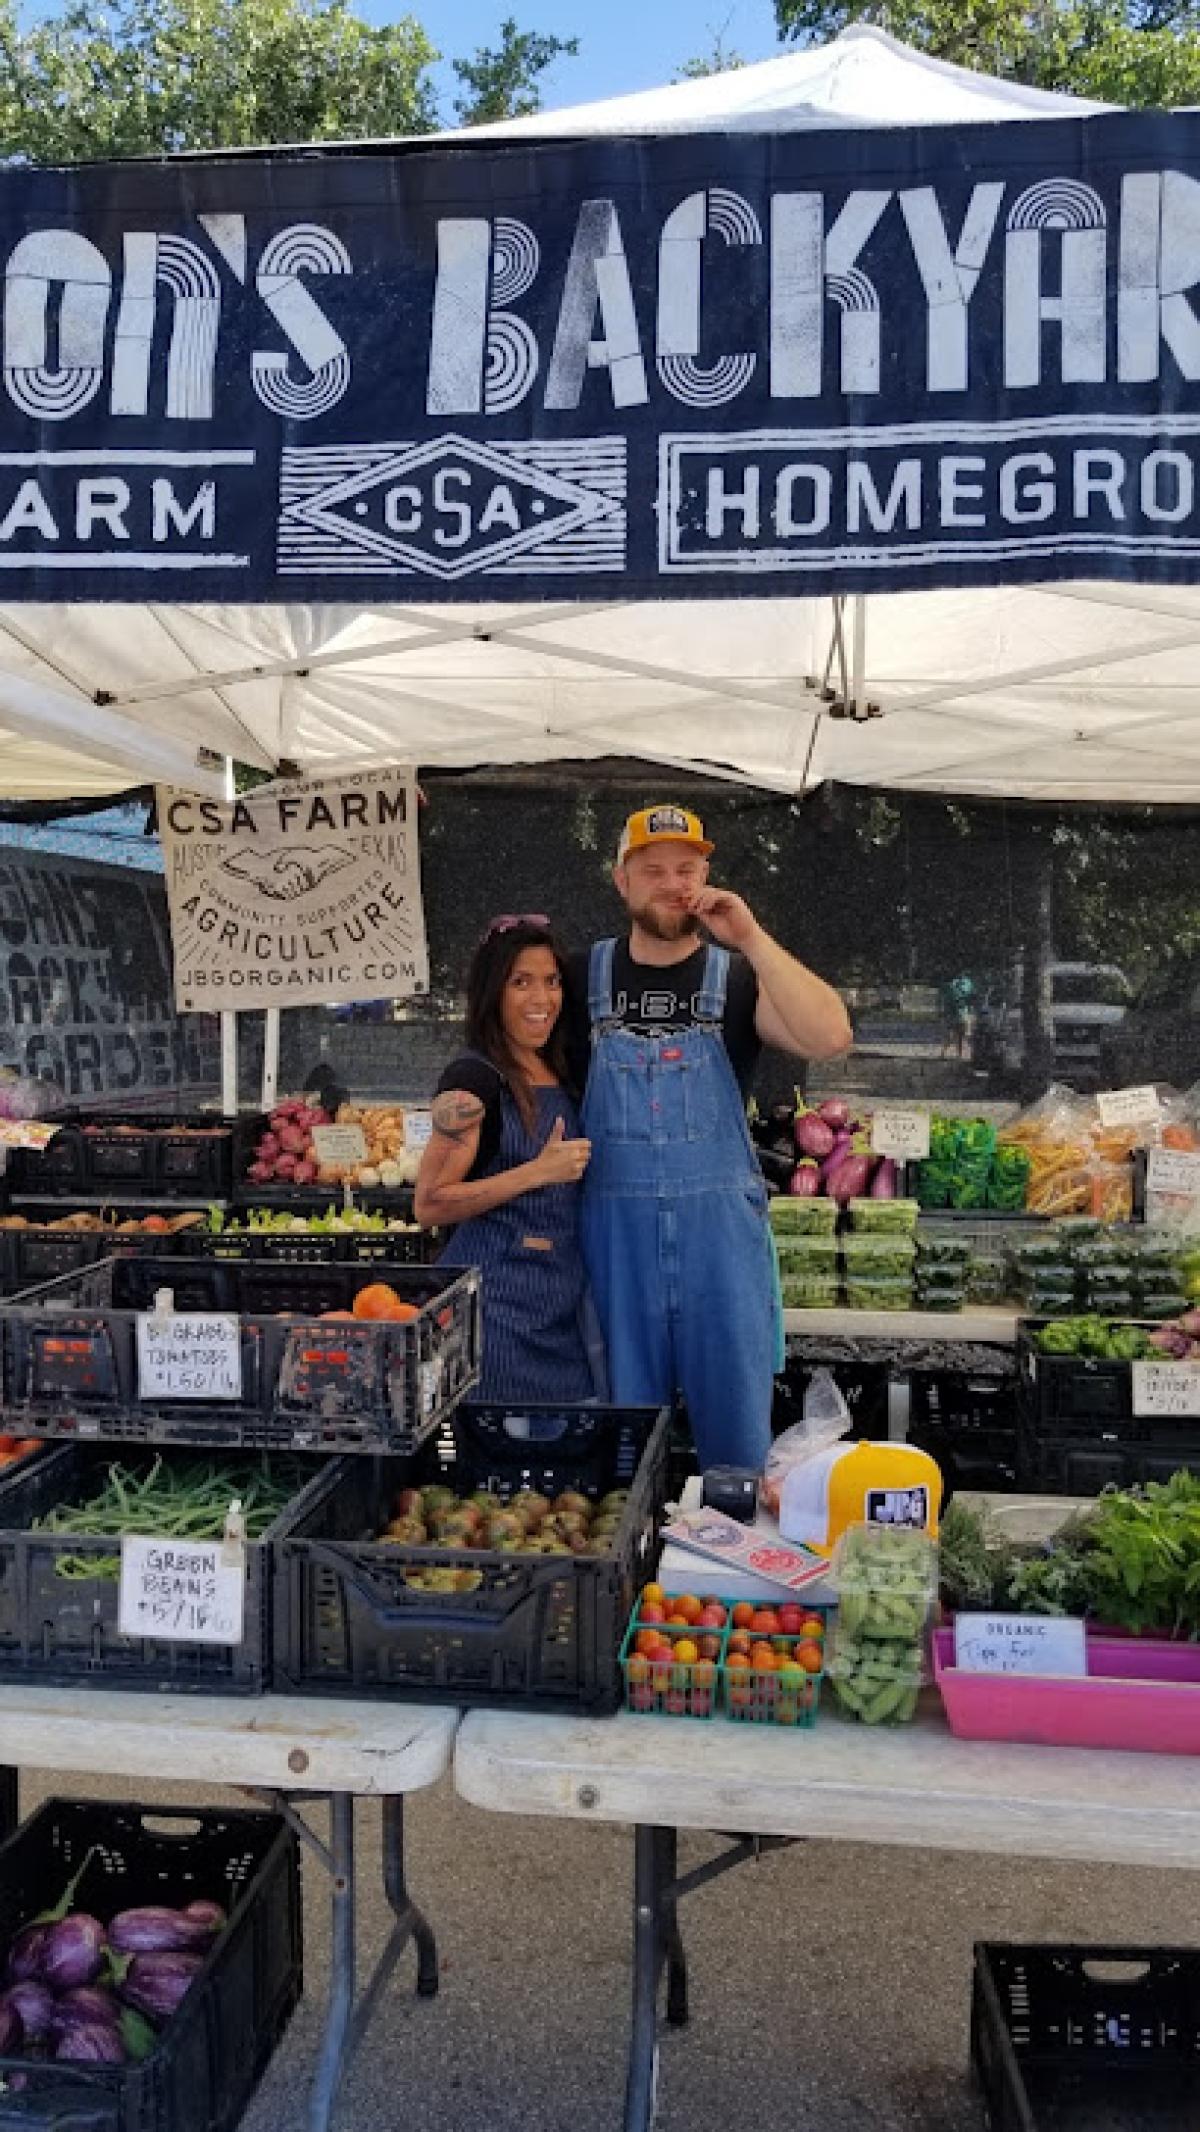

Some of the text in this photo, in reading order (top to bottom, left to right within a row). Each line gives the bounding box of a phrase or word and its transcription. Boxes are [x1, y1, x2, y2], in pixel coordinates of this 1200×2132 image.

[0, 477, 217, 541] ARM
[384, 466, 521, 549] CSA
[704, 449, 1195, 538] HOMEGRO
[167, 788, 407, 836] CSA FARM
[181, 881, 405, 962] AGRICULTURE
[181, 961, 416, 987] JBGORGANIC.COM
[141, 1573, 216, 1599] BEANS
[146, 1549, 216, 1574] GREEN
